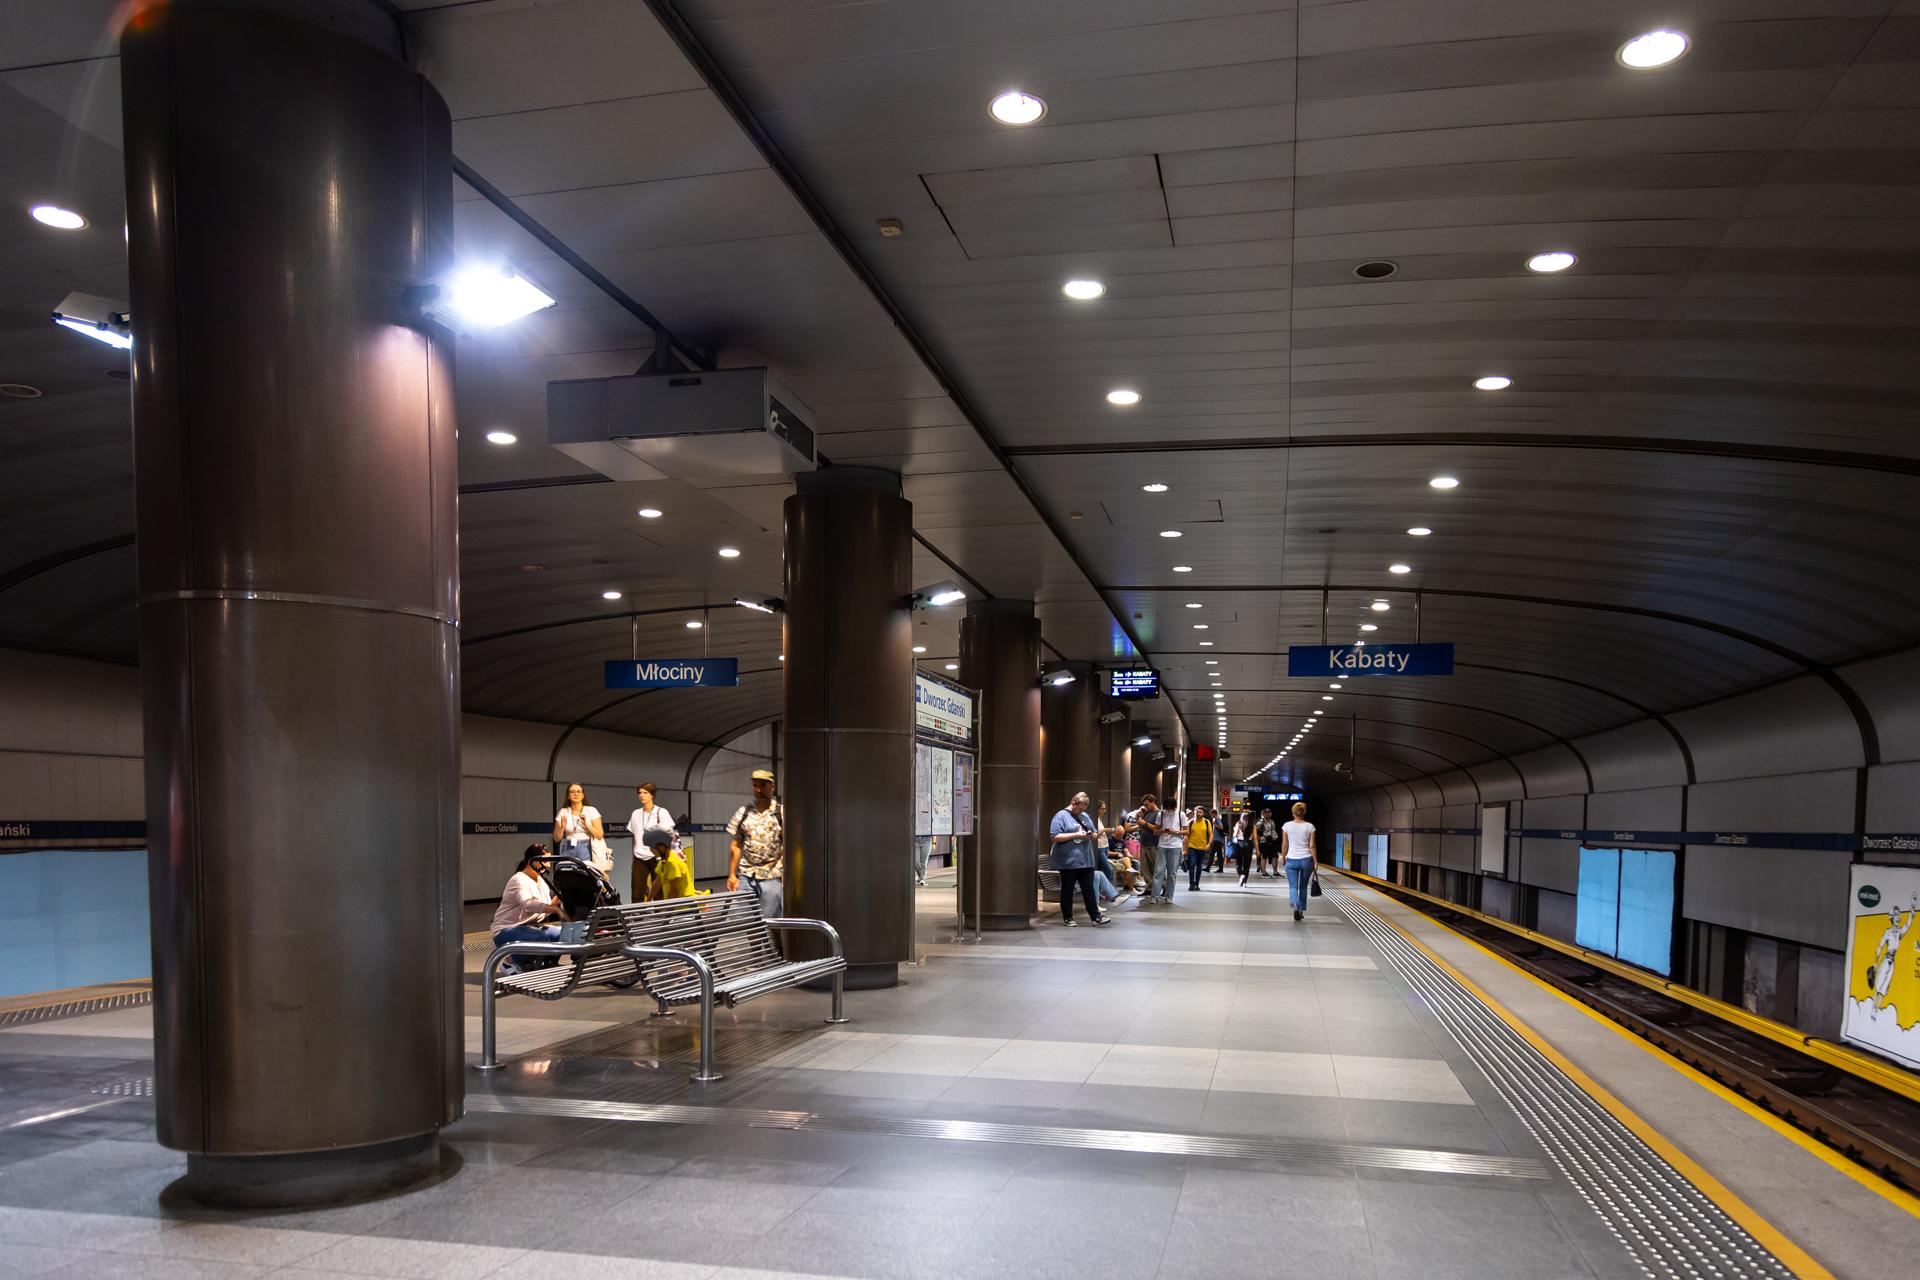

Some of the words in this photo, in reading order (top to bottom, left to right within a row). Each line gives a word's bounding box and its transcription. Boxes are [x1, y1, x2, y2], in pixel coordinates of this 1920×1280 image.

[1329, 650, 1410, 672] Kabaty
[636, 663, 704, 684] Młociny
[923, 687, 946, 712] Dworzec
[475, 824, 497, 833] Dworzec
